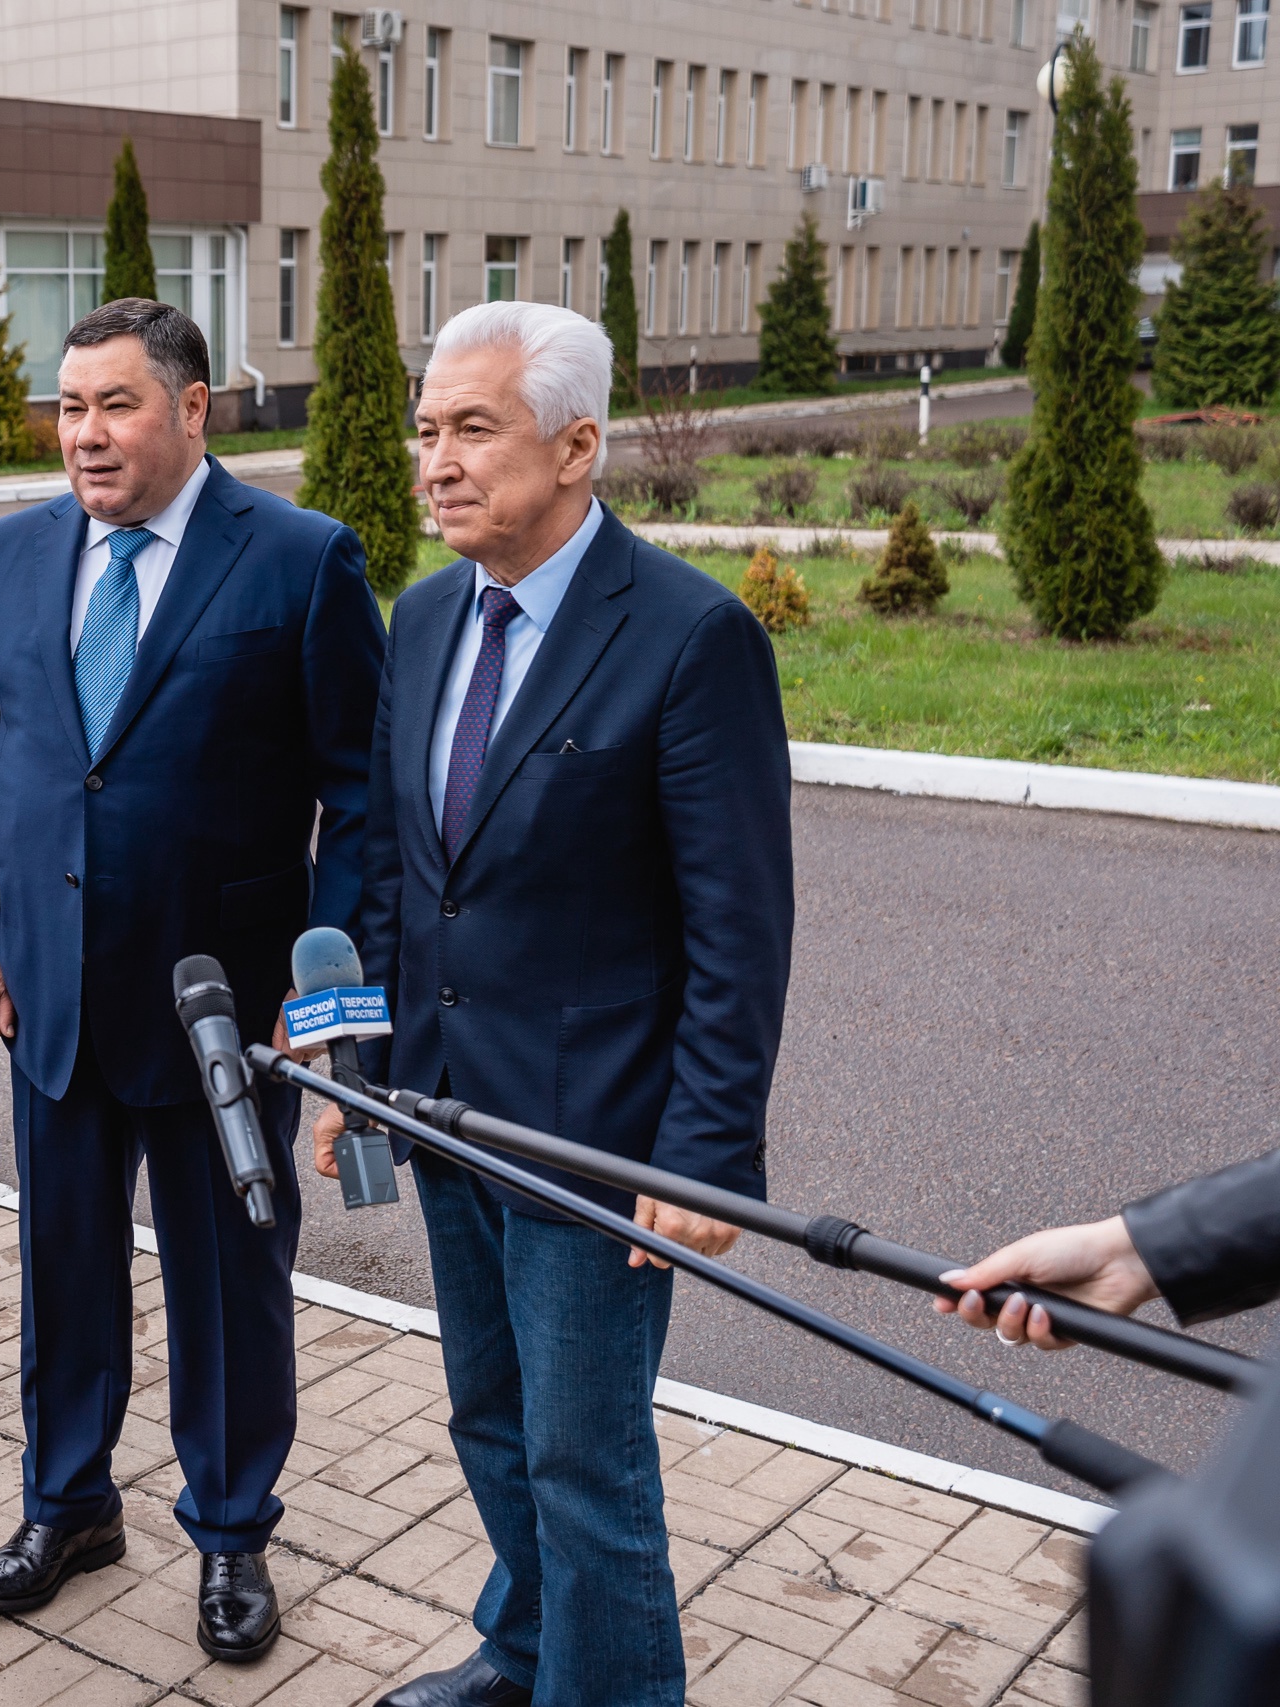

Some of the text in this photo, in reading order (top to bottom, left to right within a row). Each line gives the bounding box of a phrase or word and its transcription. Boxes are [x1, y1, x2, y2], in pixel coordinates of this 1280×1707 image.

[287, 997, 337, 1022] ТВЕРСКОЙ
[339, 995, 385, 1008] ТВЕРСКОЙ
[345, 1008, 383, 1019] ПРОСПЕКТ
[293, 1012, 334, 1032] ПРОСПЕКТ
